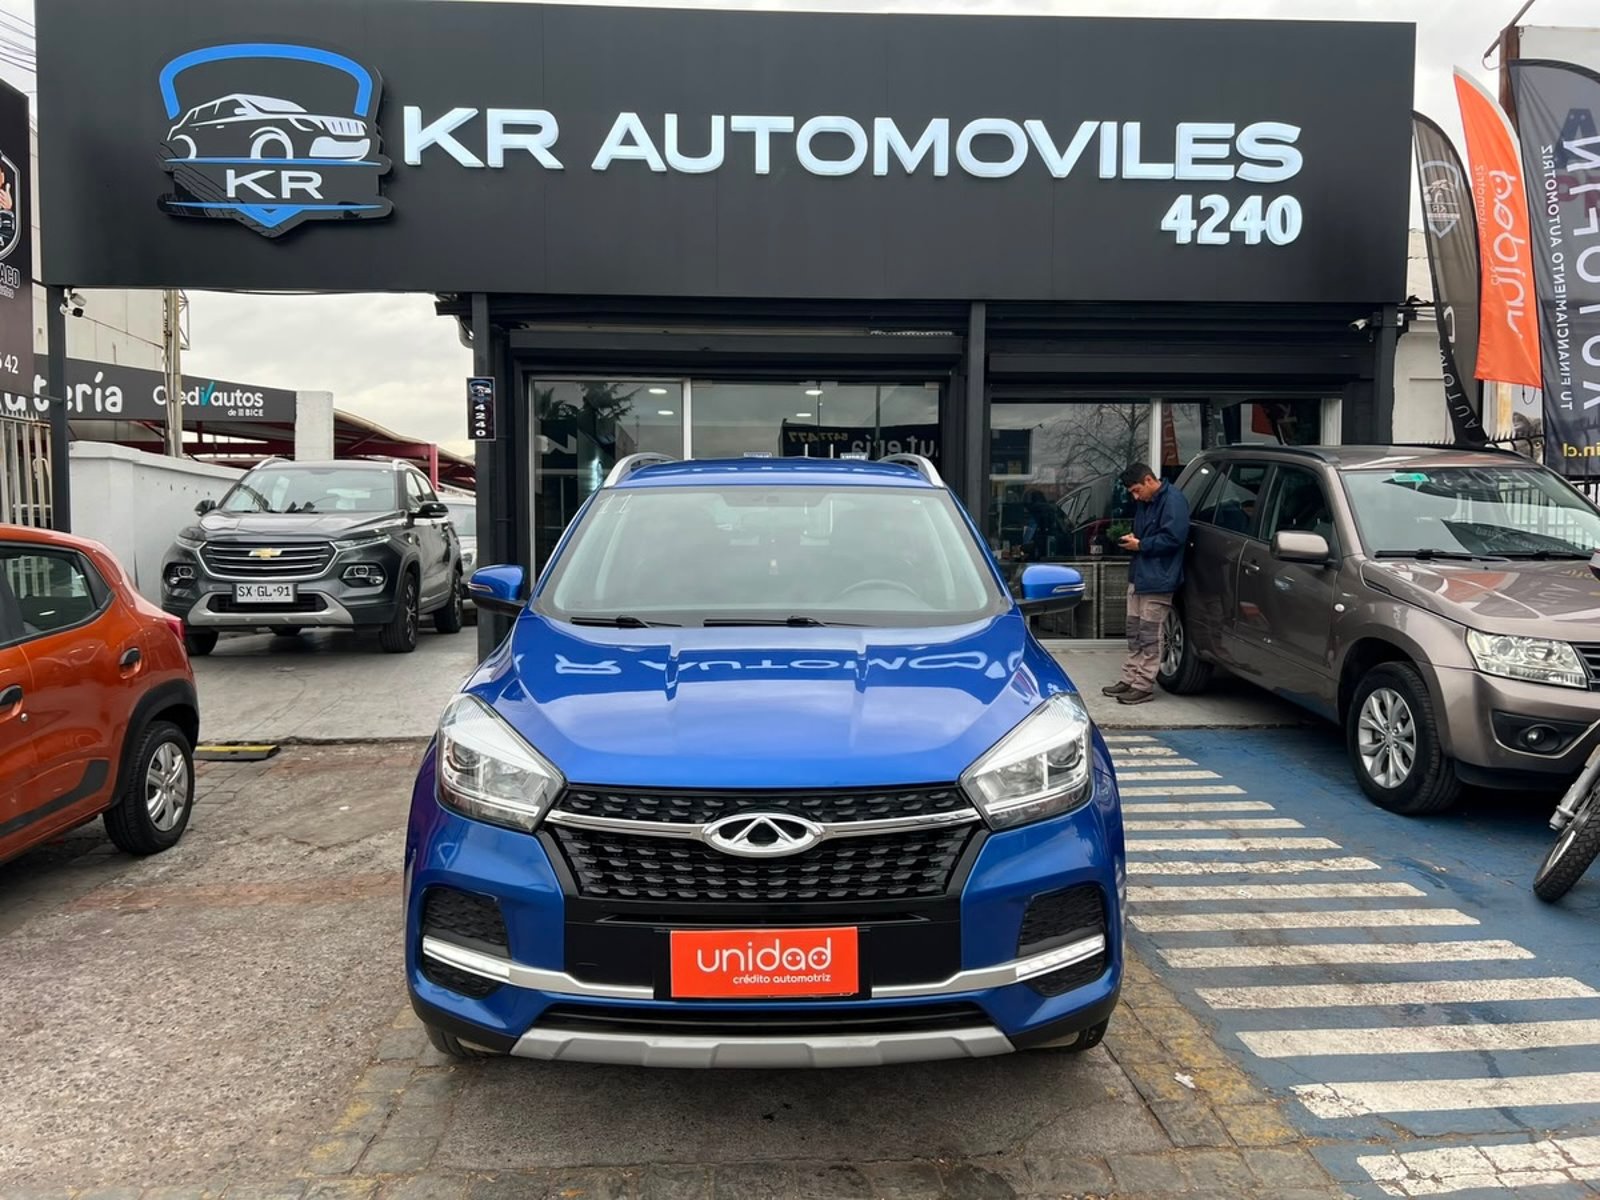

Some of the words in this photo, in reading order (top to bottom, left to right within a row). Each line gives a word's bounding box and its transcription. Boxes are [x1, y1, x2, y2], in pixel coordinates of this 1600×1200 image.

[403, 105, 565, 170] KR
[591, 112, 1304, 184] AUTOMOVILES
[225, 169, 323, 199] KR
[1161, 194, 1303, 246] 4240
[4, 371, 123, 413] utría
[245, 409, 264, 417] BICE
[474, 403, 486, 437] 4240
[696, 937, 832, 973] unidad
[732, 974, 771, 985] crédito
[772, 973, 832, 984] automotriz
